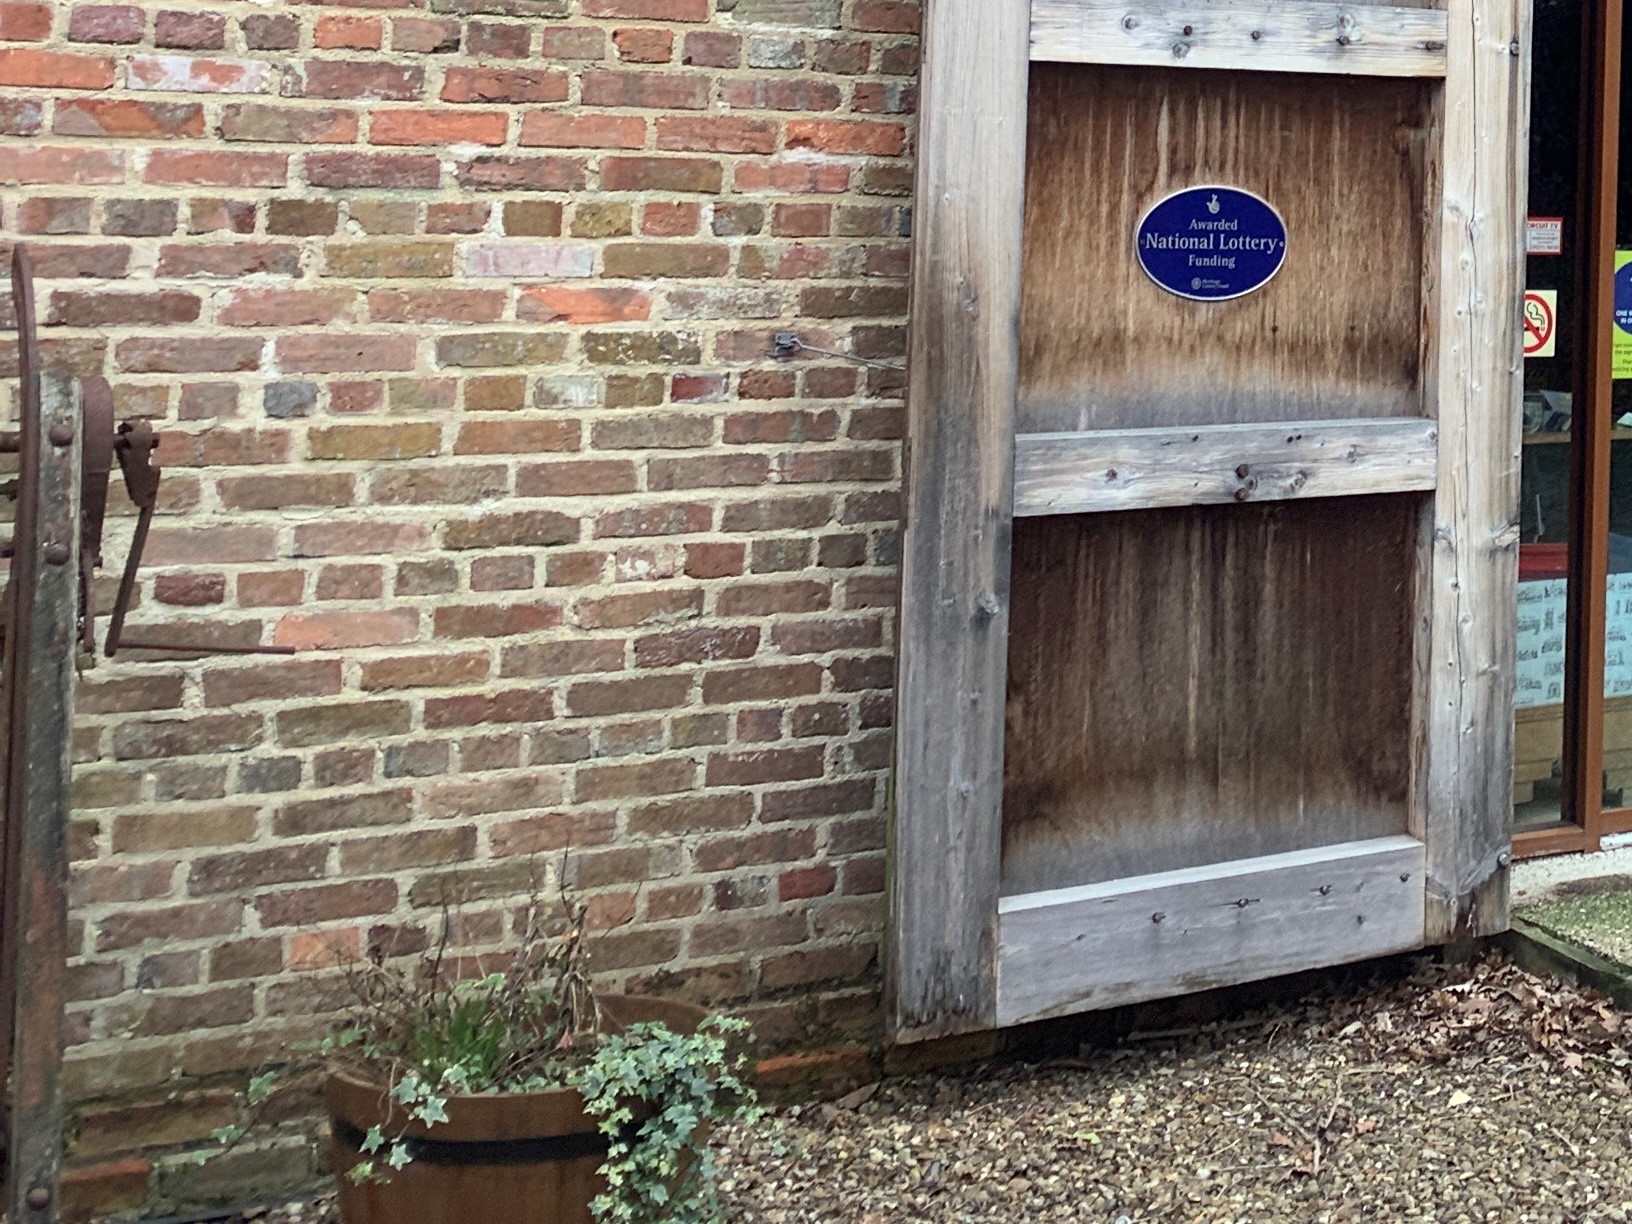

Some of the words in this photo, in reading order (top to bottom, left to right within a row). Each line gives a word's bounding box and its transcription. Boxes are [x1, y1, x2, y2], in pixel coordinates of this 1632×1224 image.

[1189, 219, 1238, 231] Awarded
[1144, 232, 1214, 250] National
[1219, 233, 1279, 255] Lottery
[1188, 254, 1236, 269] Funding
